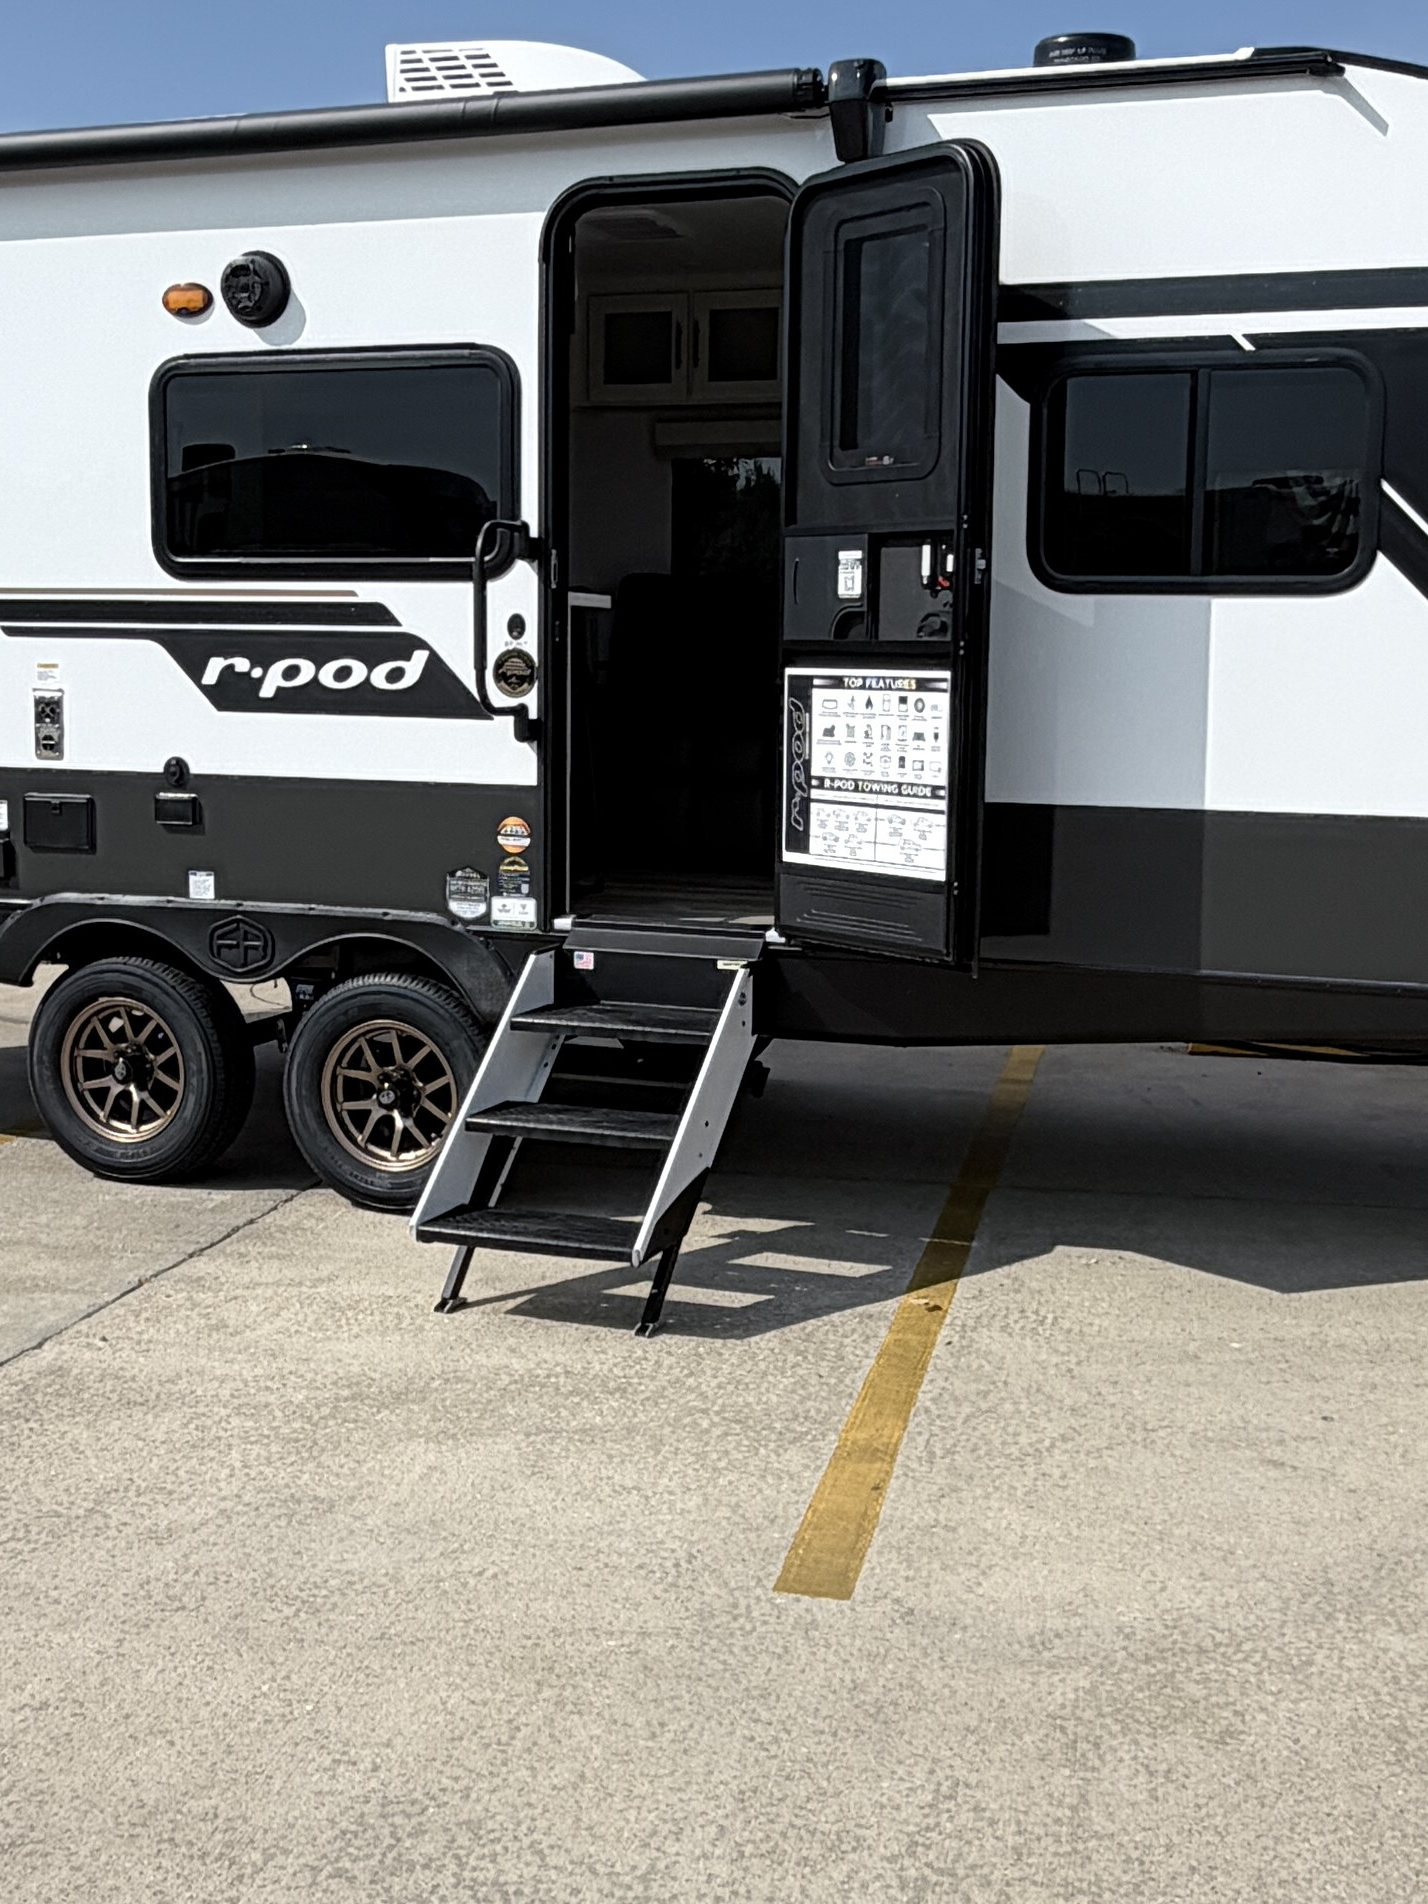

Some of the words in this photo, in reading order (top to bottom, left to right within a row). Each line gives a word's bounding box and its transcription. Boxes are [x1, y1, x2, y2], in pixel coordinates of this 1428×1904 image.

[843, 677, 863, 688] TOP
[865, 677, 916, 690] FEATURES
[824, 778, 855, 790] R-POD
[857, 781, 899, 794] TOWING
[900, 784, 932, 797] GUIDE
